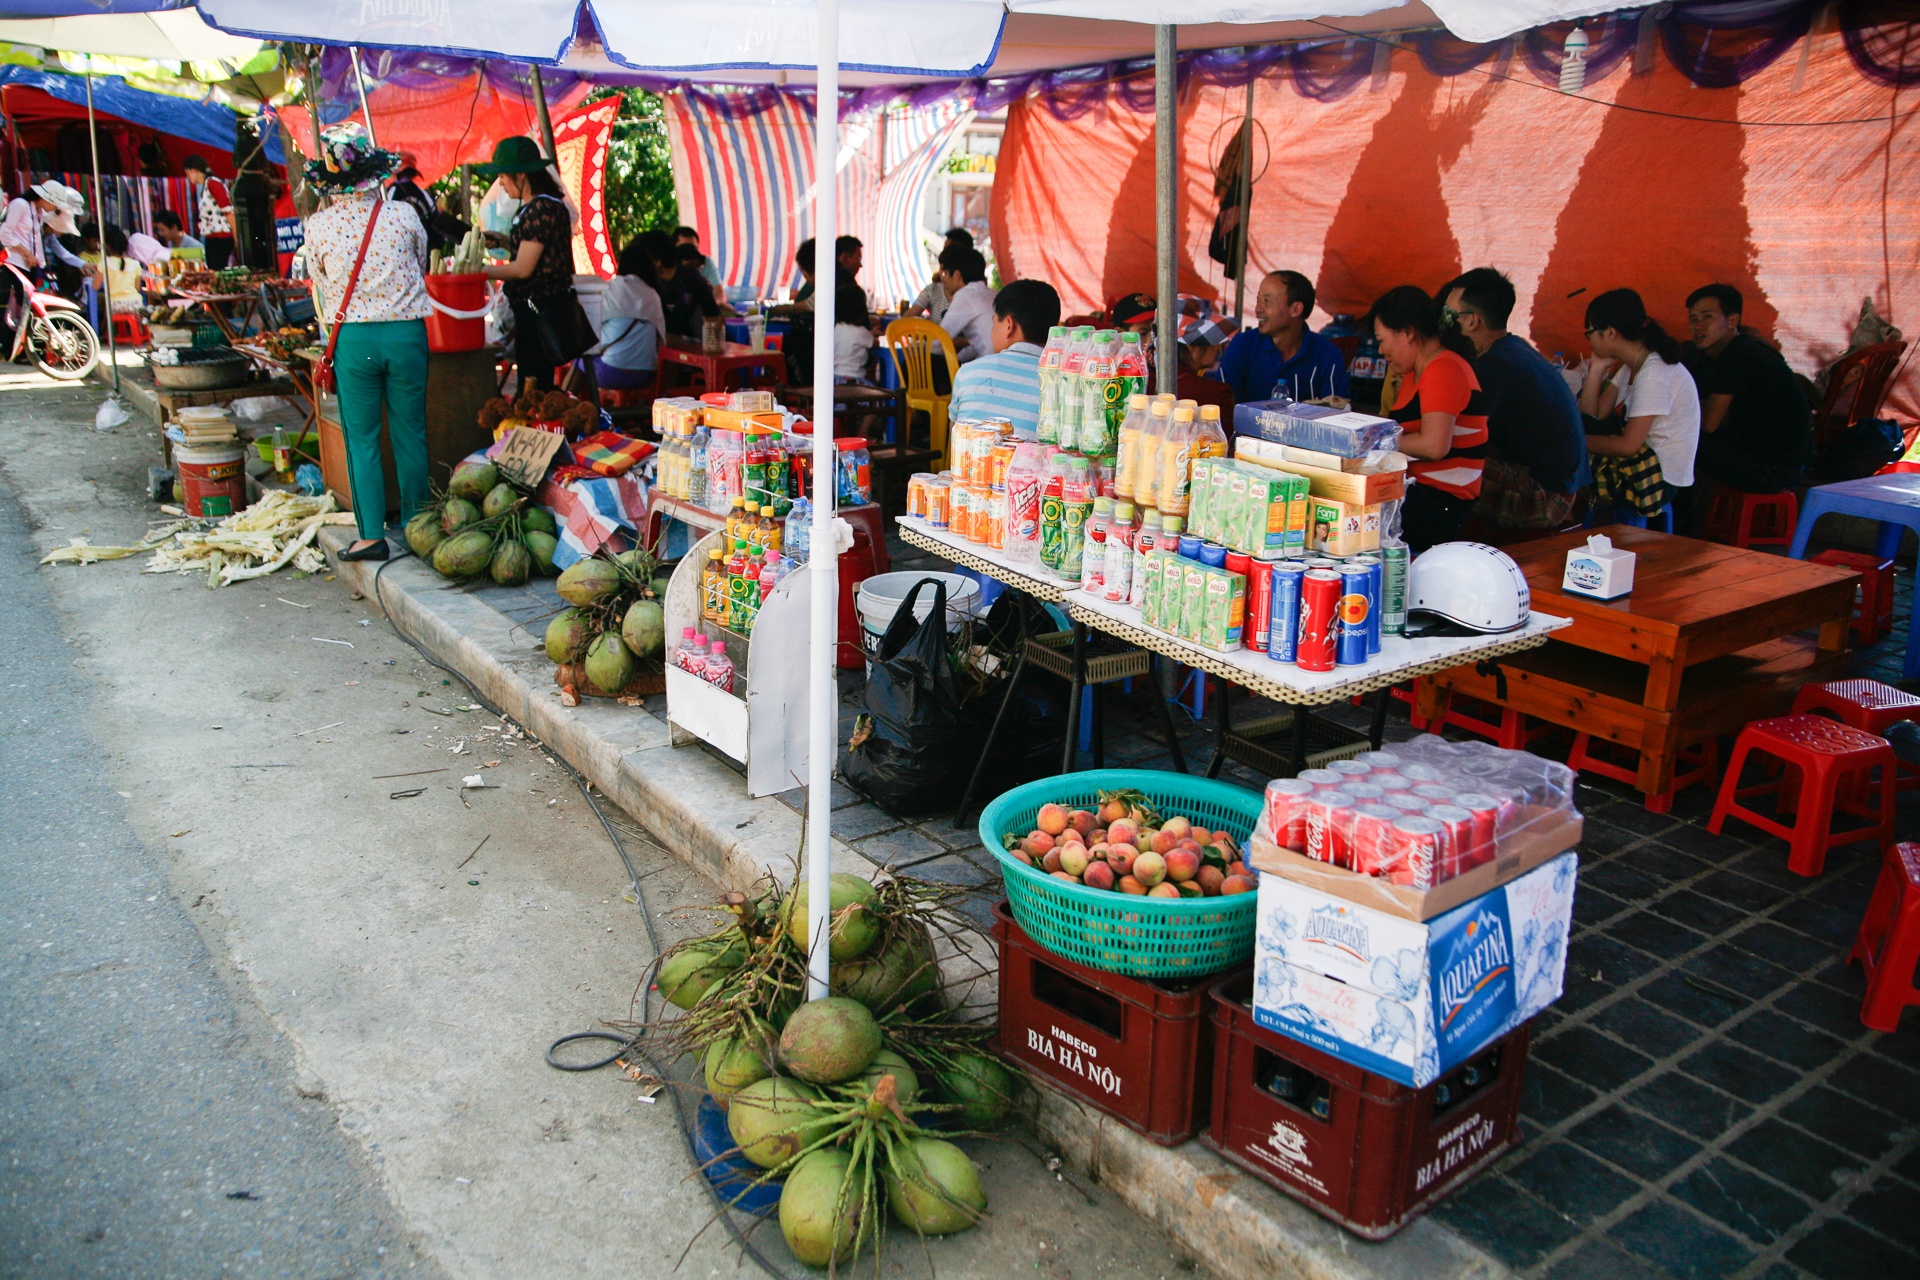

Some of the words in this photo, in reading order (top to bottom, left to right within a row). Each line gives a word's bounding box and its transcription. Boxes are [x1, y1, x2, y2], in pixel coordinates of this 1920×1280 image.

[1251, 487, 1265, 497] MILO
[1147, 560, 1160, 571] MILO
[1165, 567, 1180, 578] MILO
[1187, 574, 1202, 586] MILO
[1209, 583, 1226, 592] MILO
[1301, 907, 1372, 963] AQUAFINA
[1439, 917, 1510, 1027] AQUAFINA
[1051, 1024, 1097, 1058] HABECO
[1027, 1027, 1056, 1061] BIA
[1059, 1045, 1085, 1077] HÀ
[1087, 1061, 1122, 1097] NỘI
[1437, 1112, 1481, 1150] HABECO
[1415, 1157, 1442, 1192] BIA
[1443, 1136, 1465, 1171] HÀ
